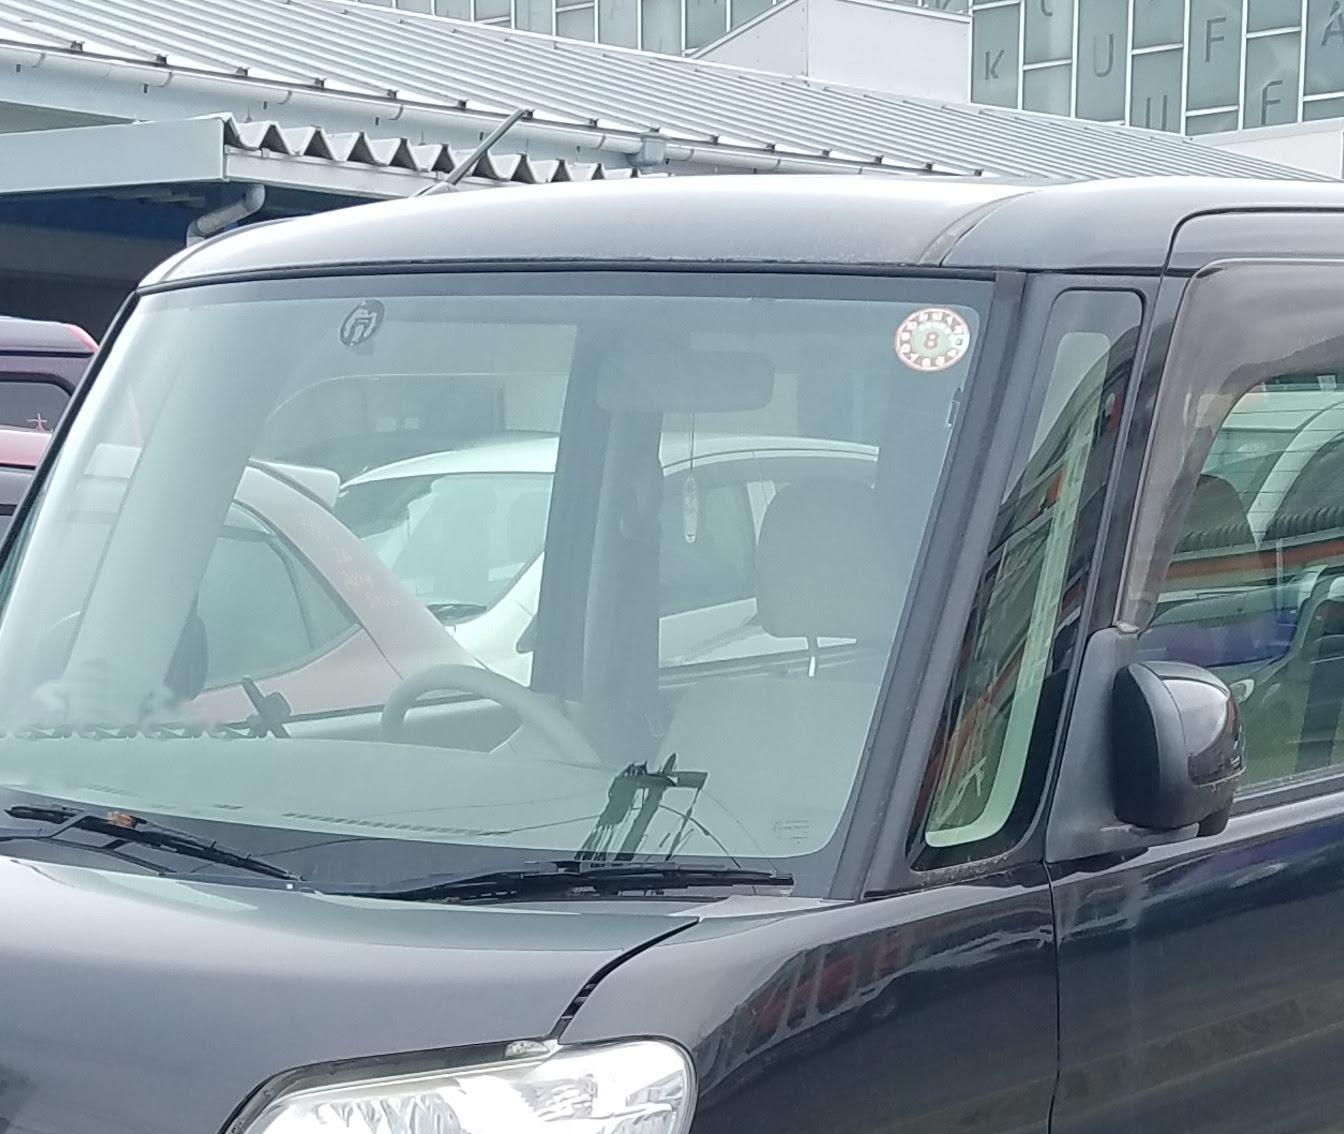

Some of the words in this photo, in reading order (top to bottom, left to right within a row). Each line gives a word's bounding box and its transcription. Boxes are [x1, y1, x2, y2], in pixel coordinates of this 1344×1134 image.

[1092, 33, 1114, 78] U
[1205, 17, 1227, 63] F
[924, 332, 939, 349] 8
